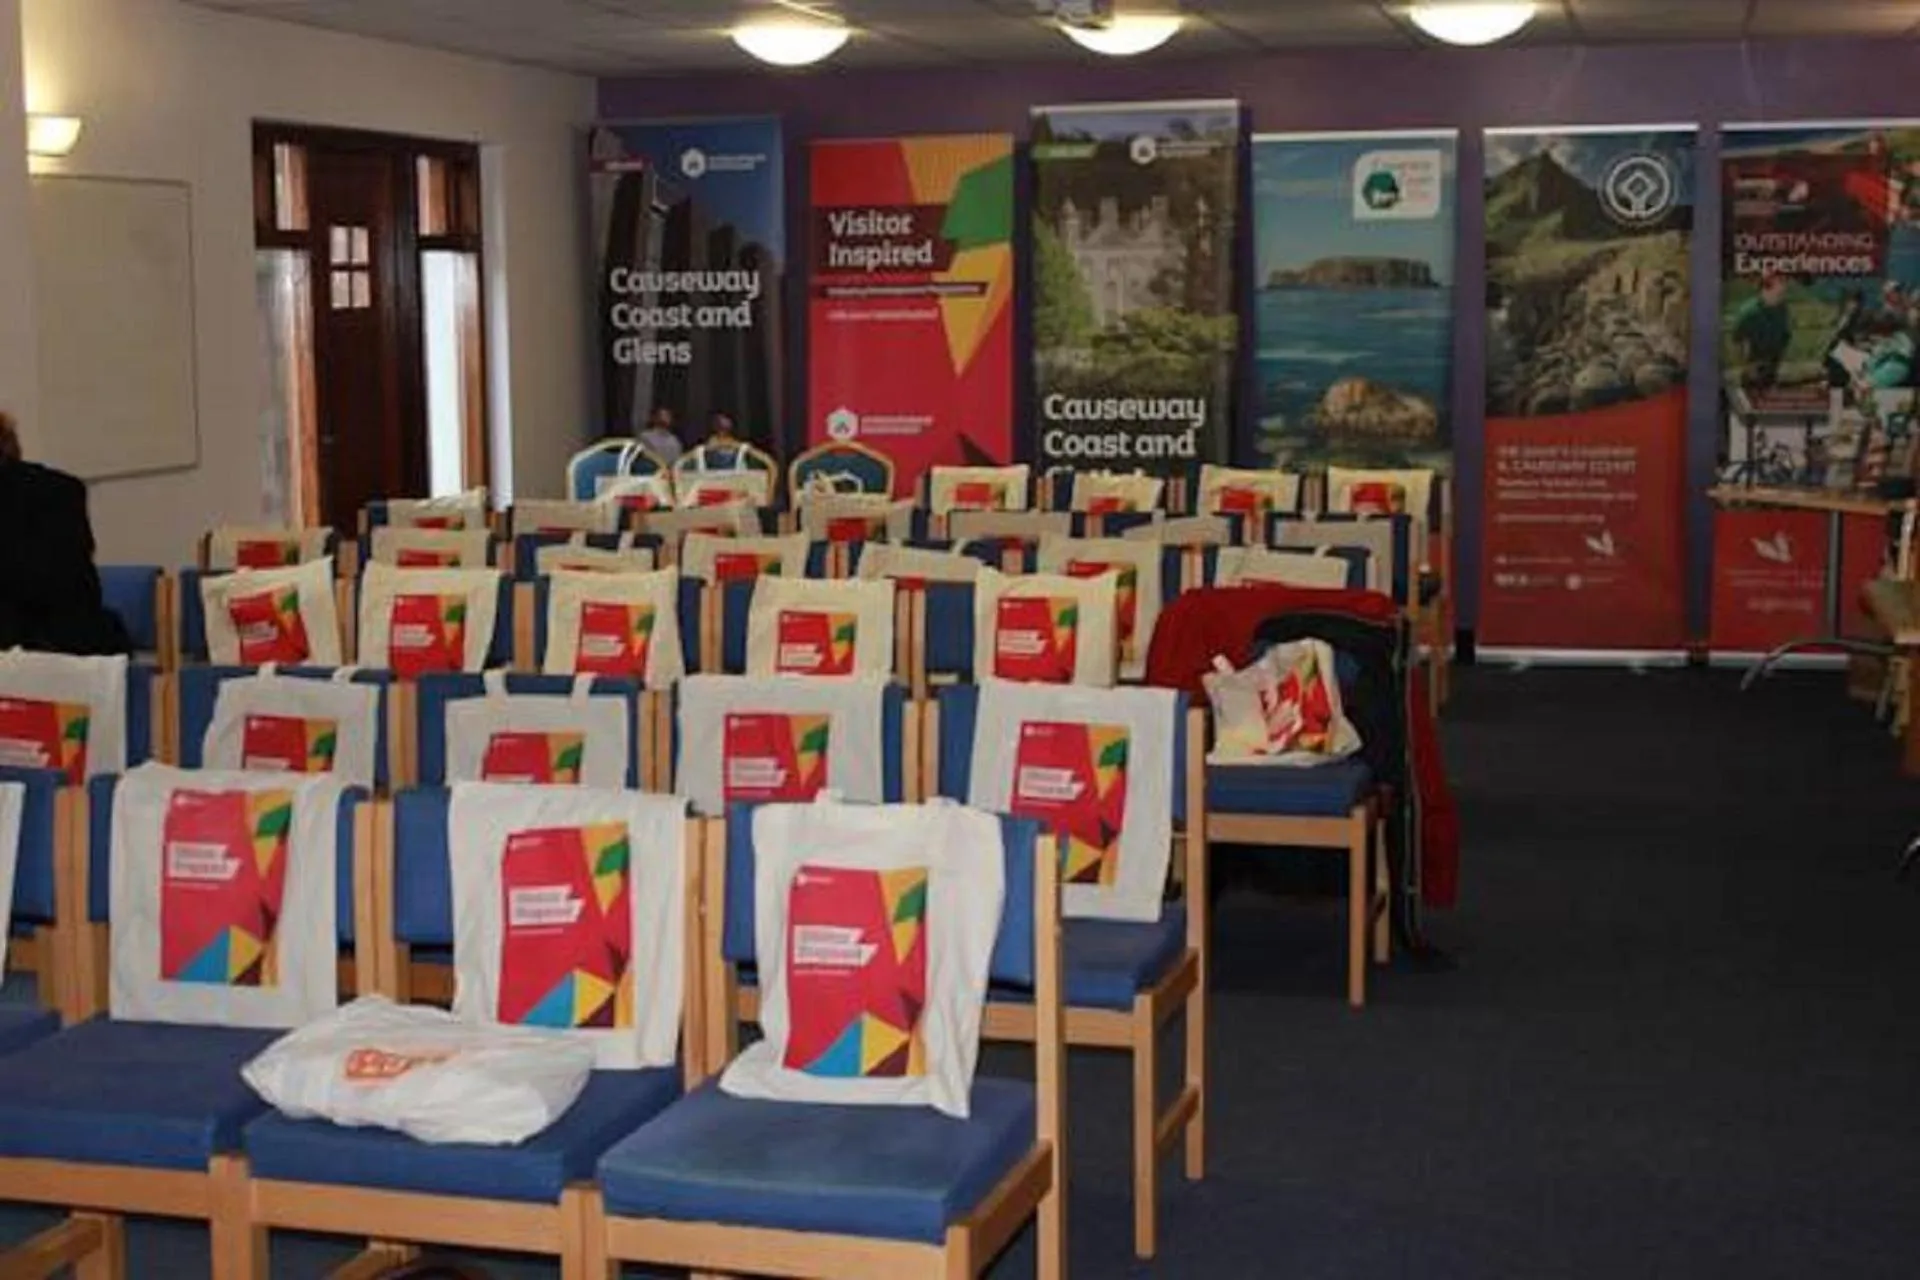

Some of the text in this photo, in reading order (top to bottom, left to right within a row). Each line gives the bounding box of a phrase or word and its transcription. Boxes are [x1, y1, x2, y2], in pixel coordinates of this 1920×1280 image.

[828, 209, 914, 236] Visitor
[828, 239, 934, 272] Inspired
[1734, 253, 1875, 279] Experiences
[610, 267, 760, 300] Causeway
[611, 301, 752, 329] Coast and
[612, 338, 692, 365] Glens
[1043, 394, 1207, 428] Causeway
[1043, 429, 1197, 458] Coast and
